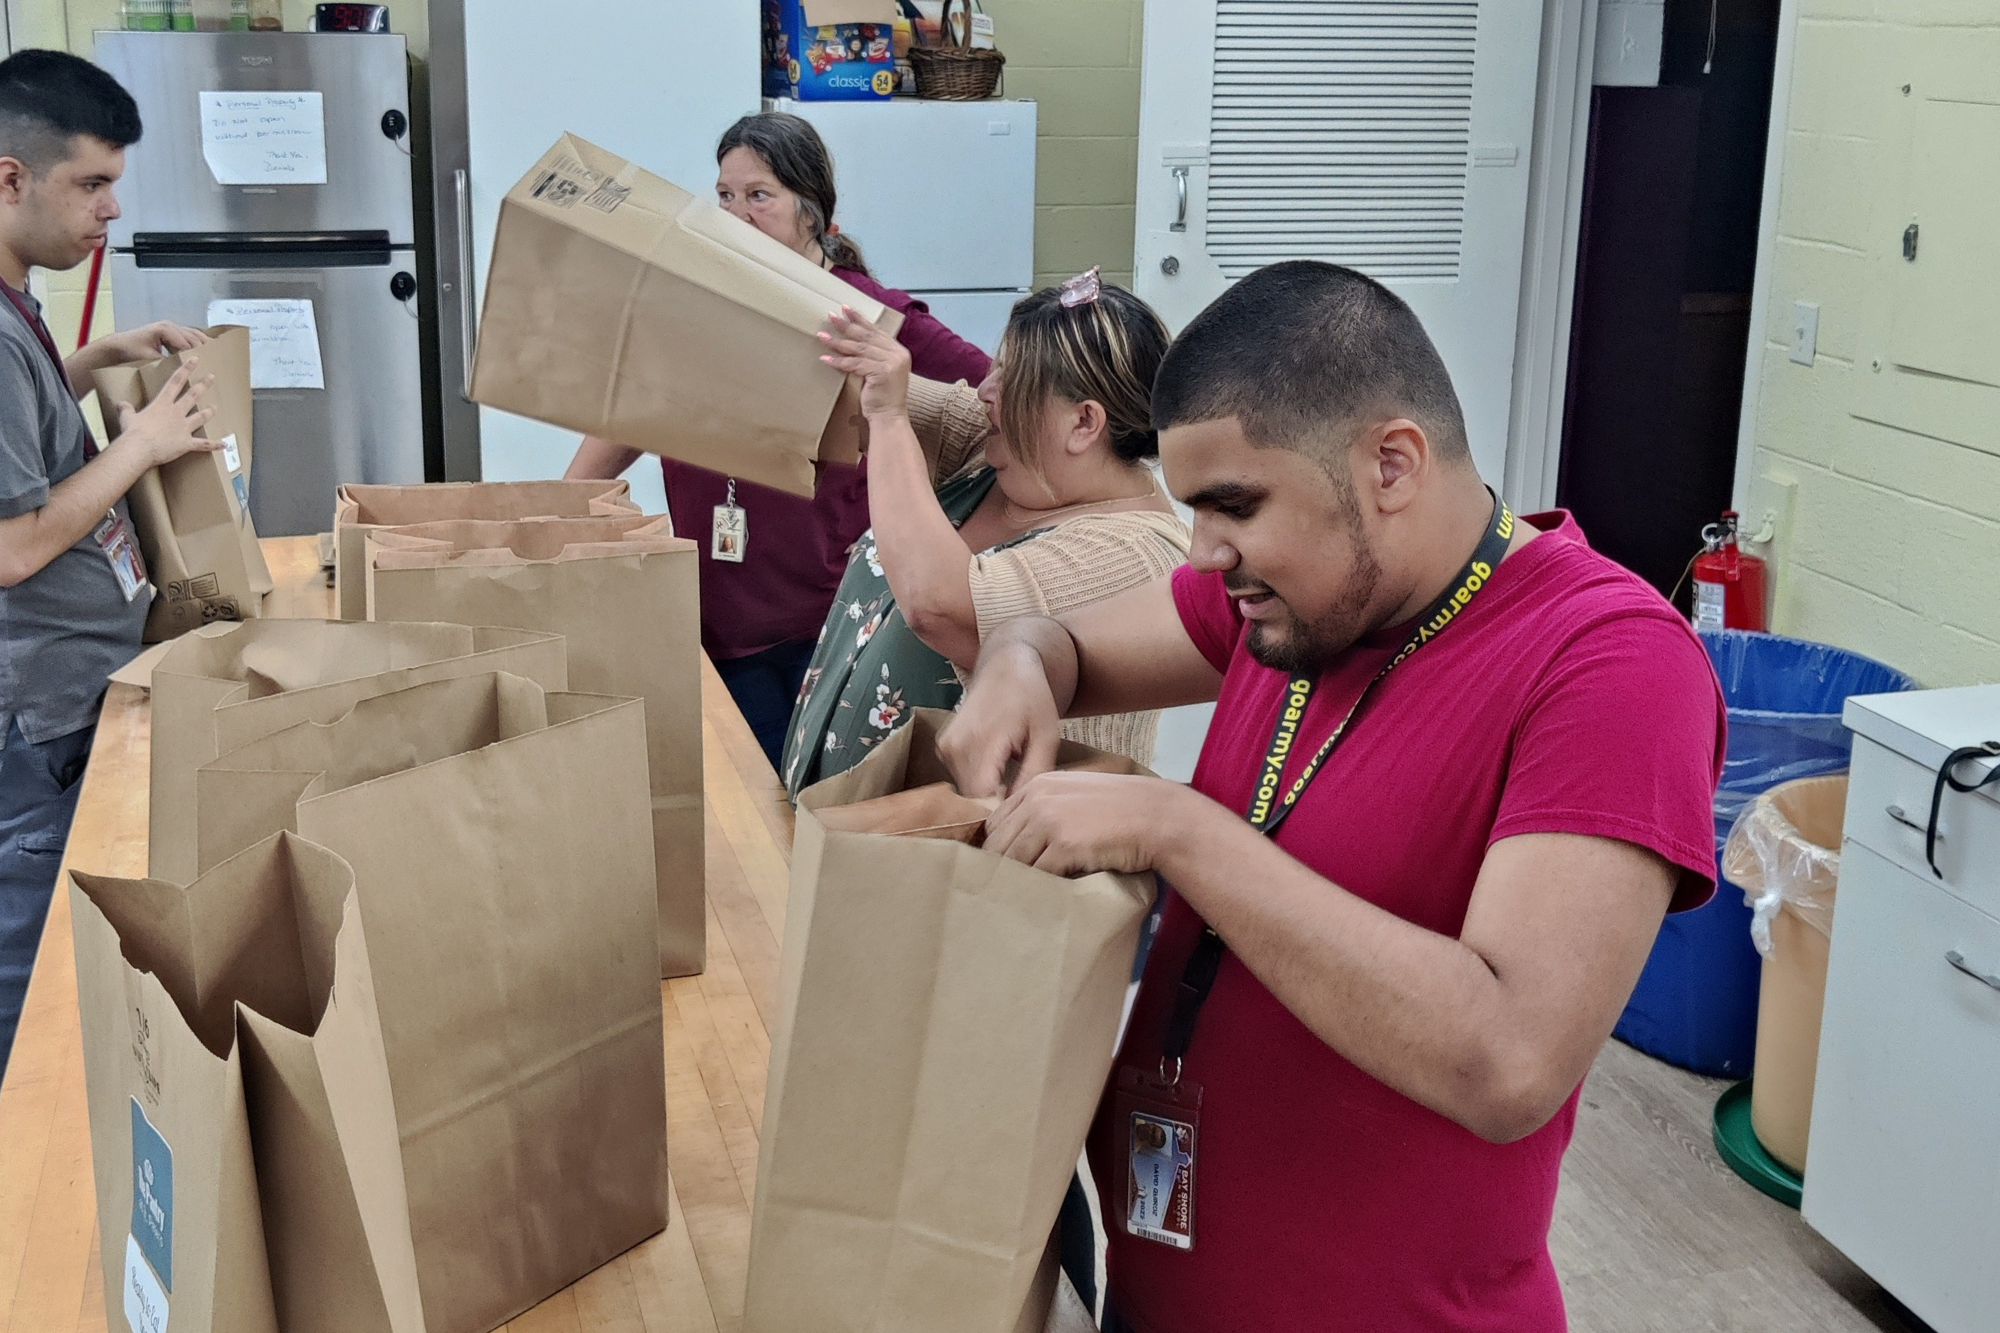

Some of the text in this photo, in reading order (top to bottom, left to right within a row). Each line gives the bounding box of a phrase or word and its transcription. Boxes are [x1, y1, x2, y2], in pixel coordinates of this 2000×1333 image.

[829, 75, 870, 88] classic
[876, 75, 889, 87] 54
[1250, 679, 1311, 824] goarmy.com
[1180, 1169, 1189, 1230] BAY SHORE
